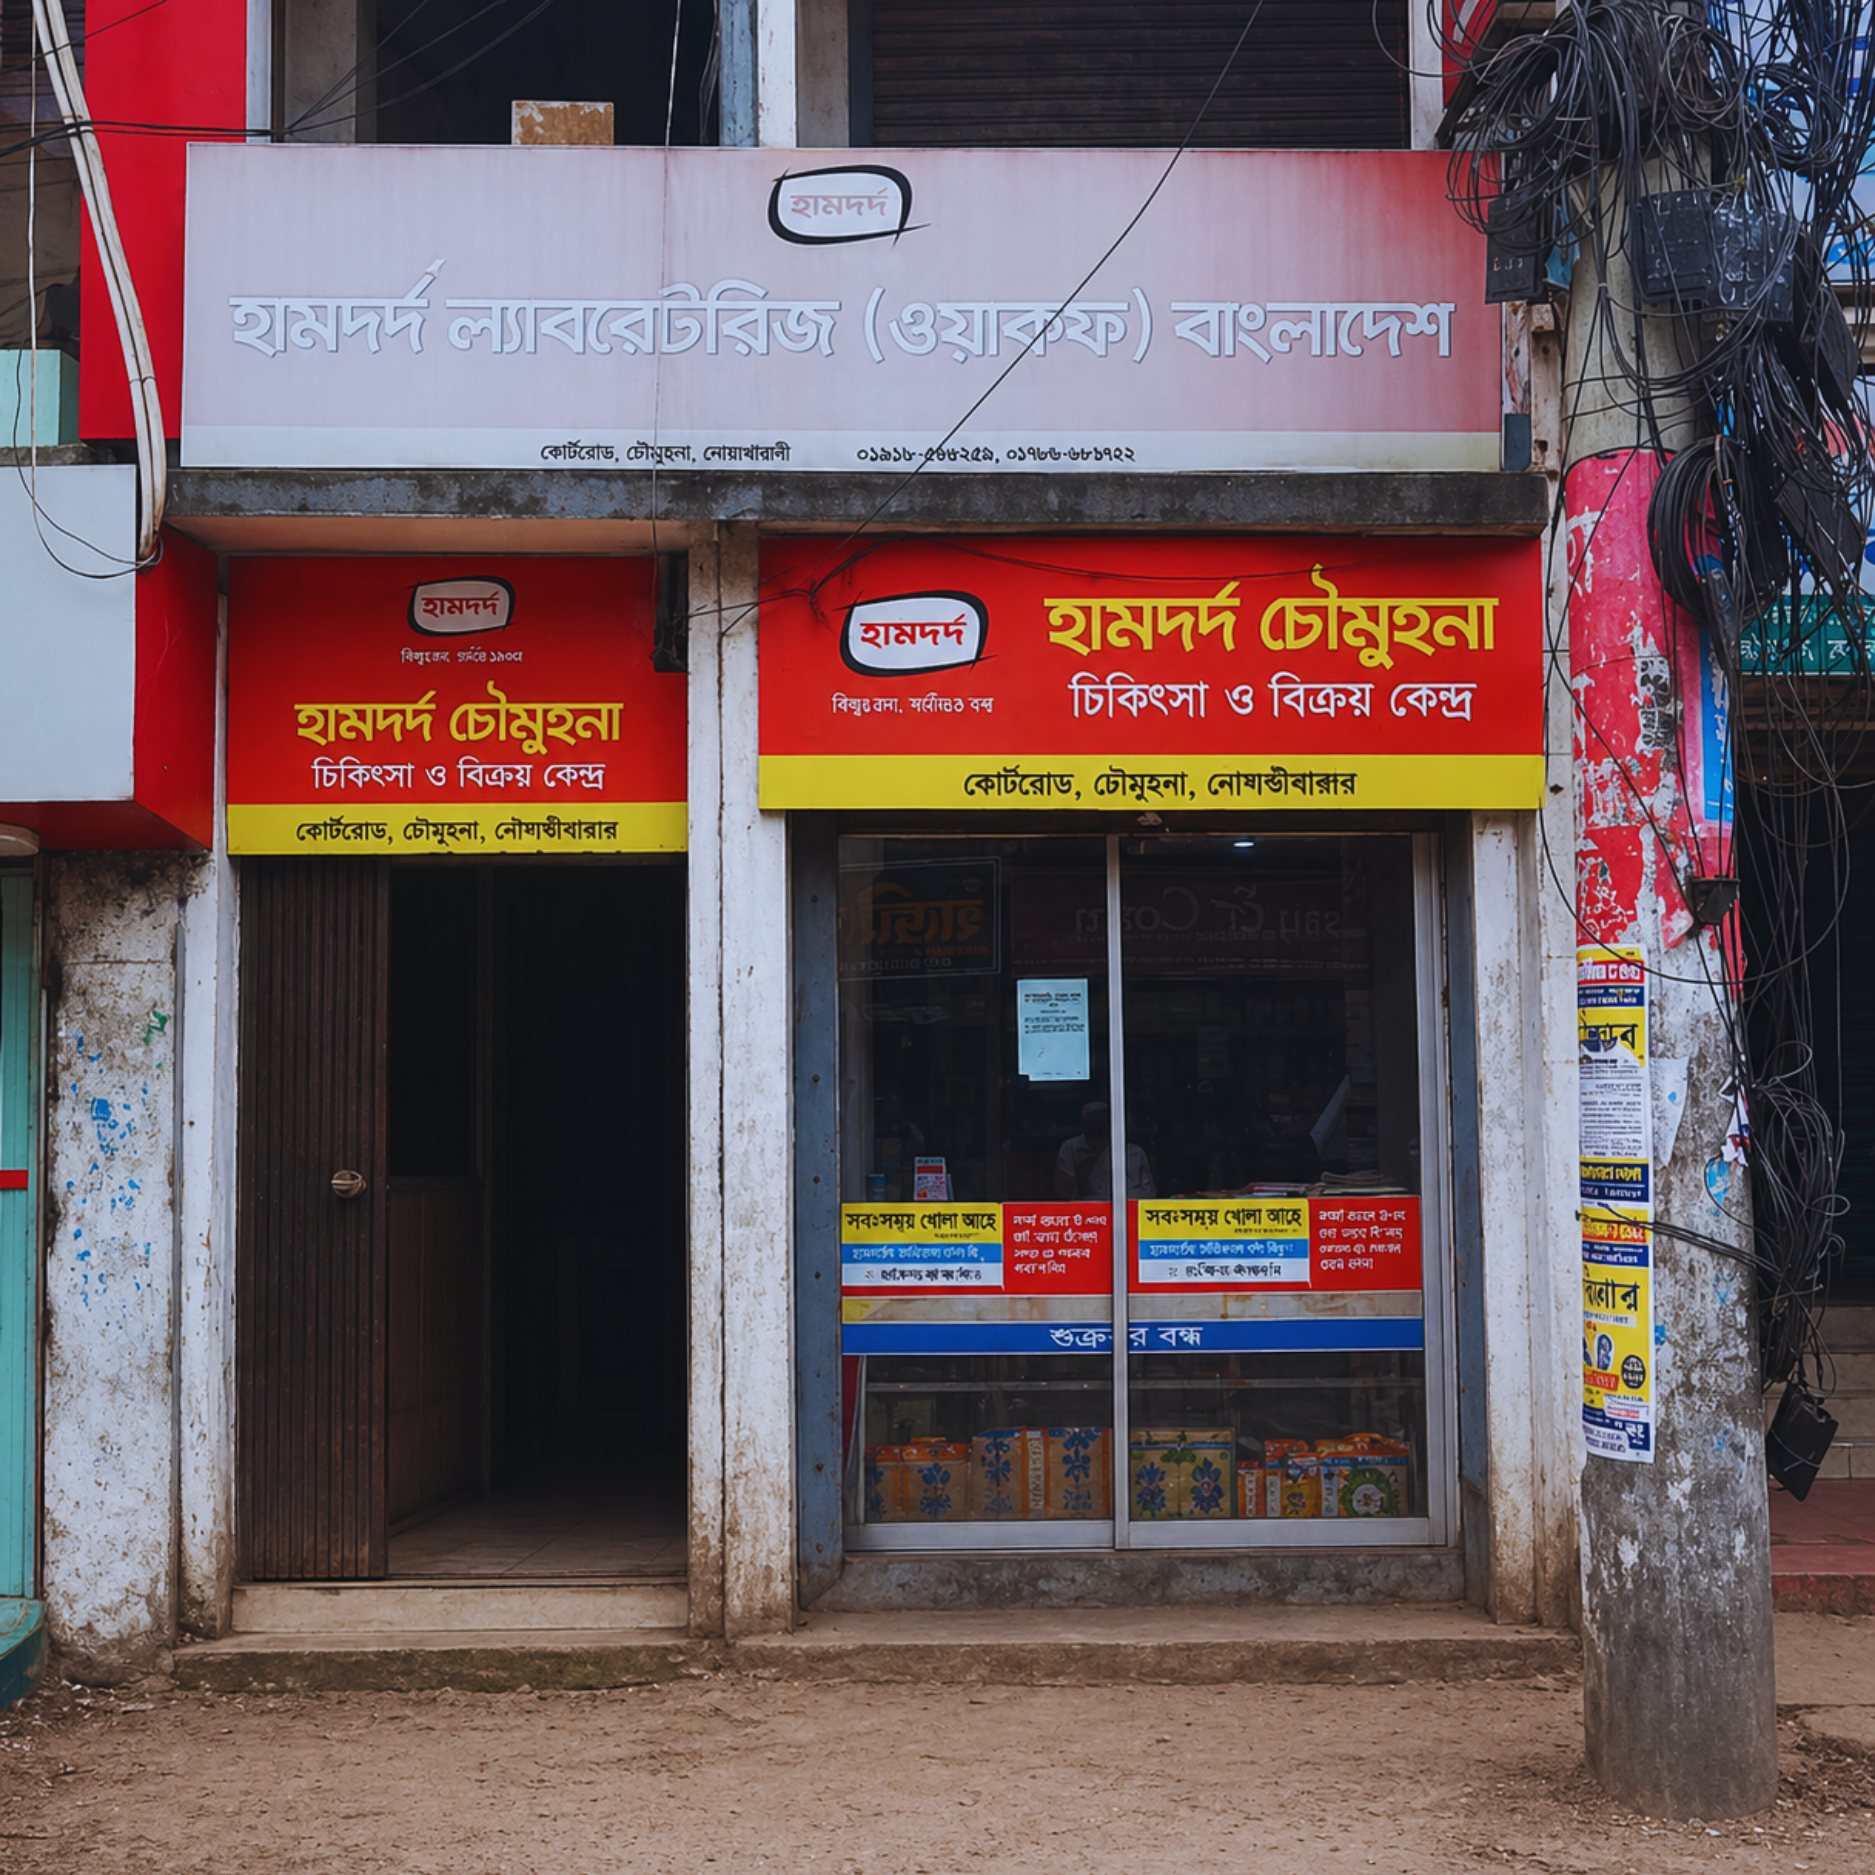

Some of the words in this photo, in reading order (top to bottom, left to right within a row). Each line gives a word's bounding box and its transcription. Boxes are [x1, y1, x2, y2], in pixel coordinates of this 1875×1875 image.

[790, 187, 890, 219] হামদর্দ
[229, 257, 446, 358] হামদর্দ
[446, 278, 841, 358] ল্যাবরেটরিজ
[864, 286, 1152, 363] (ওয়াকফ)
[1171, 300, 1454, 363] বাংলাদেশ
[541, 440, 620, 463] কোর্টরোড,
[421, 592, 501, 617] হামদর্দ
[1043, 580, 1242, 656] হামদর্দ
[1259, 563, 1500, 670] চৌমুহনা
[860, 613, 968, 649] হামদর্দ
[1068, 672, 1209, 718] চিকিৎসা
[1224, 685, 1254, 715] ও
[1268, 671, 1374, 718] বিক্রয়
[1389, 682, 1478, 722] কেন্দ্র
[294, 690, 436, 746] হামদর্দ
[449, 680, 625, 755] চৌমুহনা
[311, 757, 414, 789] চিকিৎসা
[425, 767, 447, 787] ও
[456, 756, 533, 789] বিক্রয়
[543, 763, 606, 791] কেন্দ্র
[963, 764, 1082, 803] কোর্টরোড,
[1094, 764, 1196, 804] চৌমুহনা,
[296, 815, 394, 846] কোর্টরোড,
[402, 816, 486, 847] চৌমুহনা,
